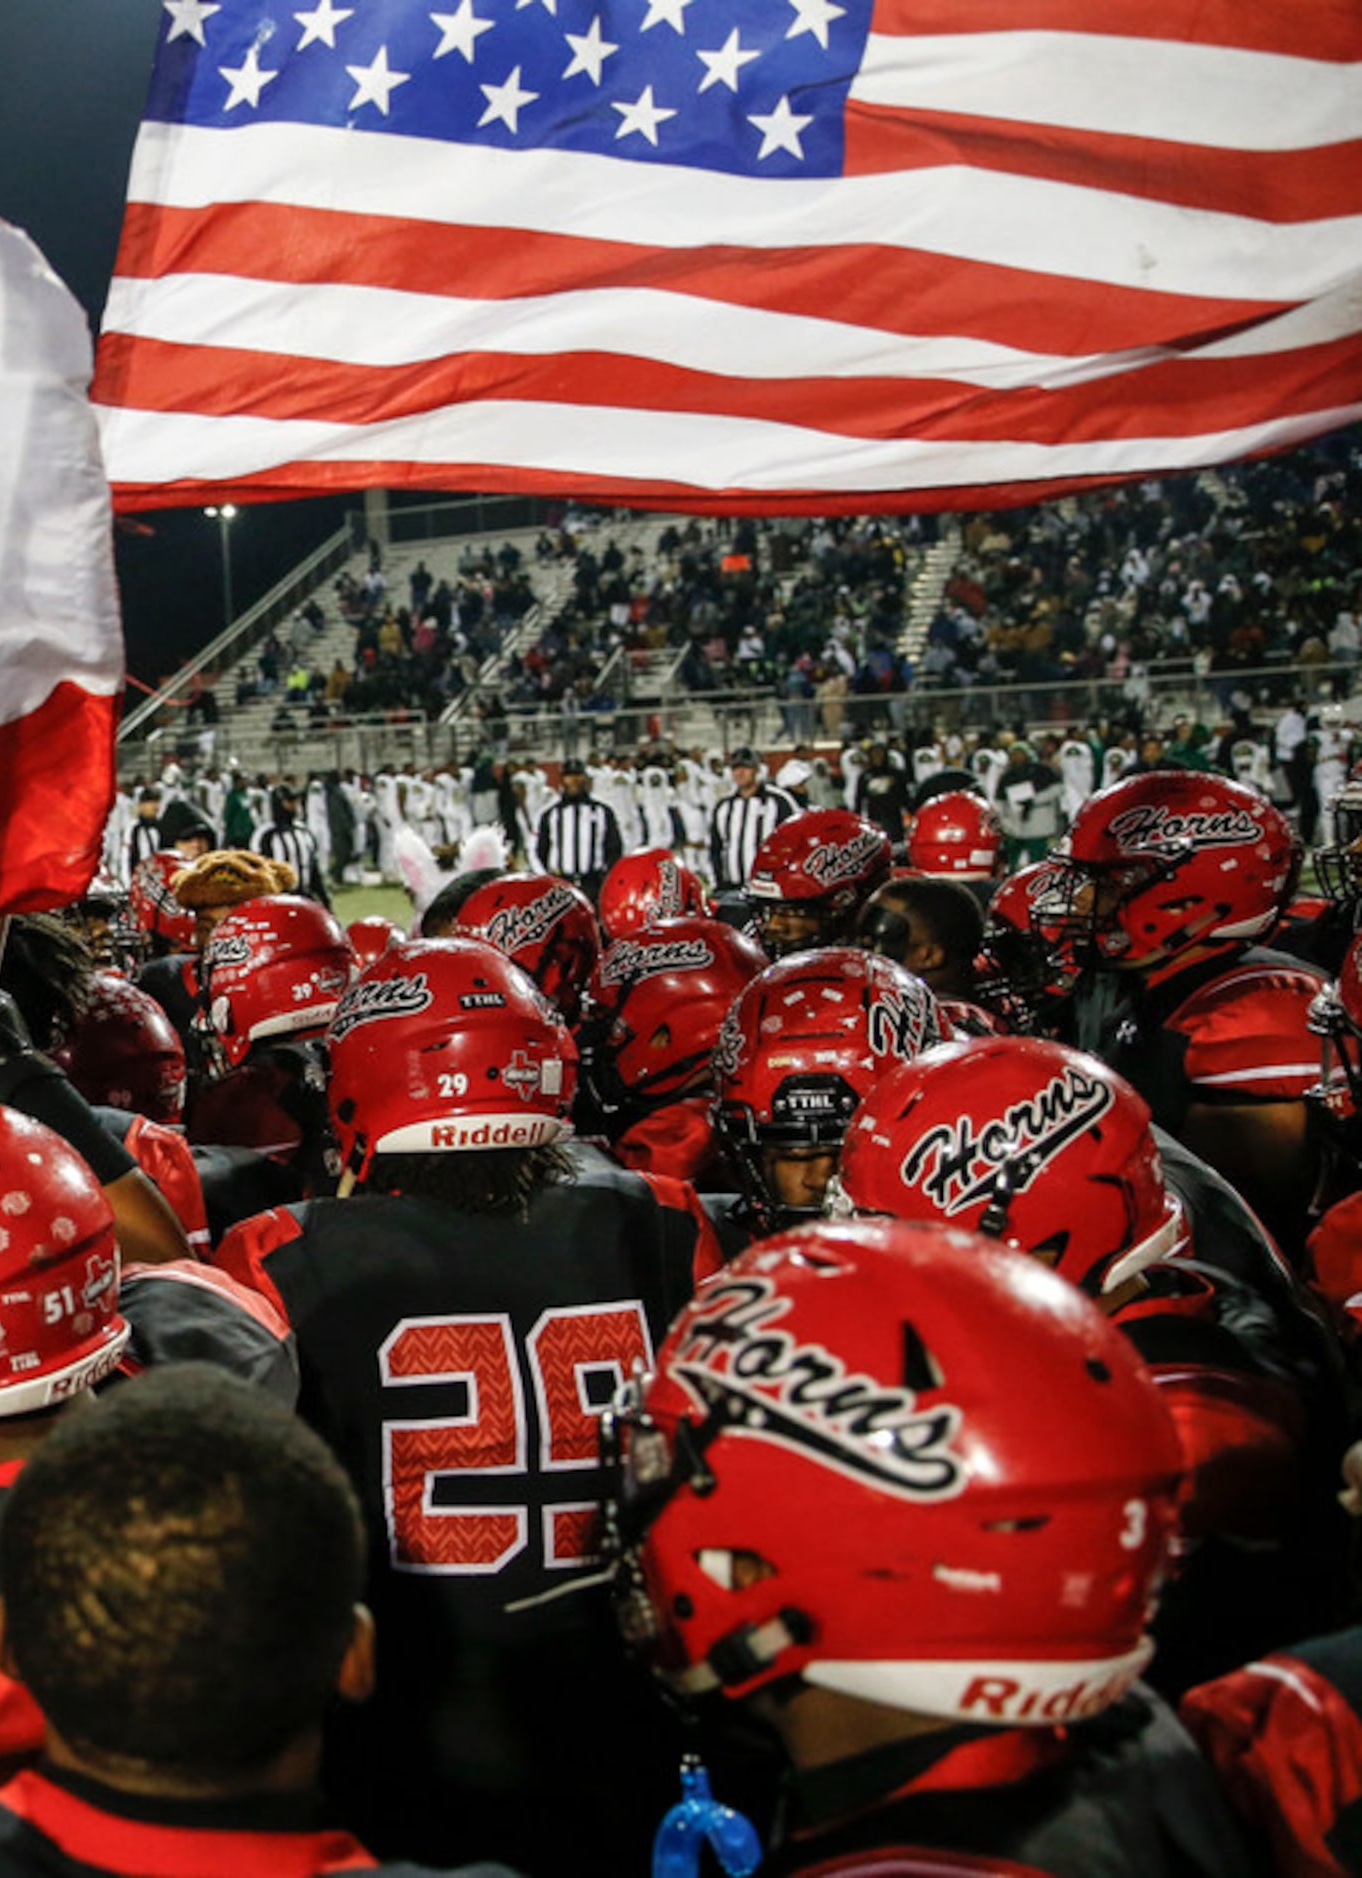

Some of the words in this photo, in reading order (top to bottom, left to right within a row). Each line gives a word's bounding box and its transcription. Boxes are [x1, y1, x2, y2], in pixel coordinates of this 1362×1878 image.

[1110, 806, 1263, 858] Horns
[461, 994, 504, 1009] TTHL
[437, 1073, 468, 1097] 29
[786, 1095, 835, 1109] TTHL
[431, 1122, 546, 1148] Riddell
[900, 1066, 1115, 1216] Horns
[43, 1285, 76, 1324] 51
[670, 1276, 970, 1504] Horns
[376, 1299, 656, 1575] 29
[1120, 1499, 1147, 1549] 3
